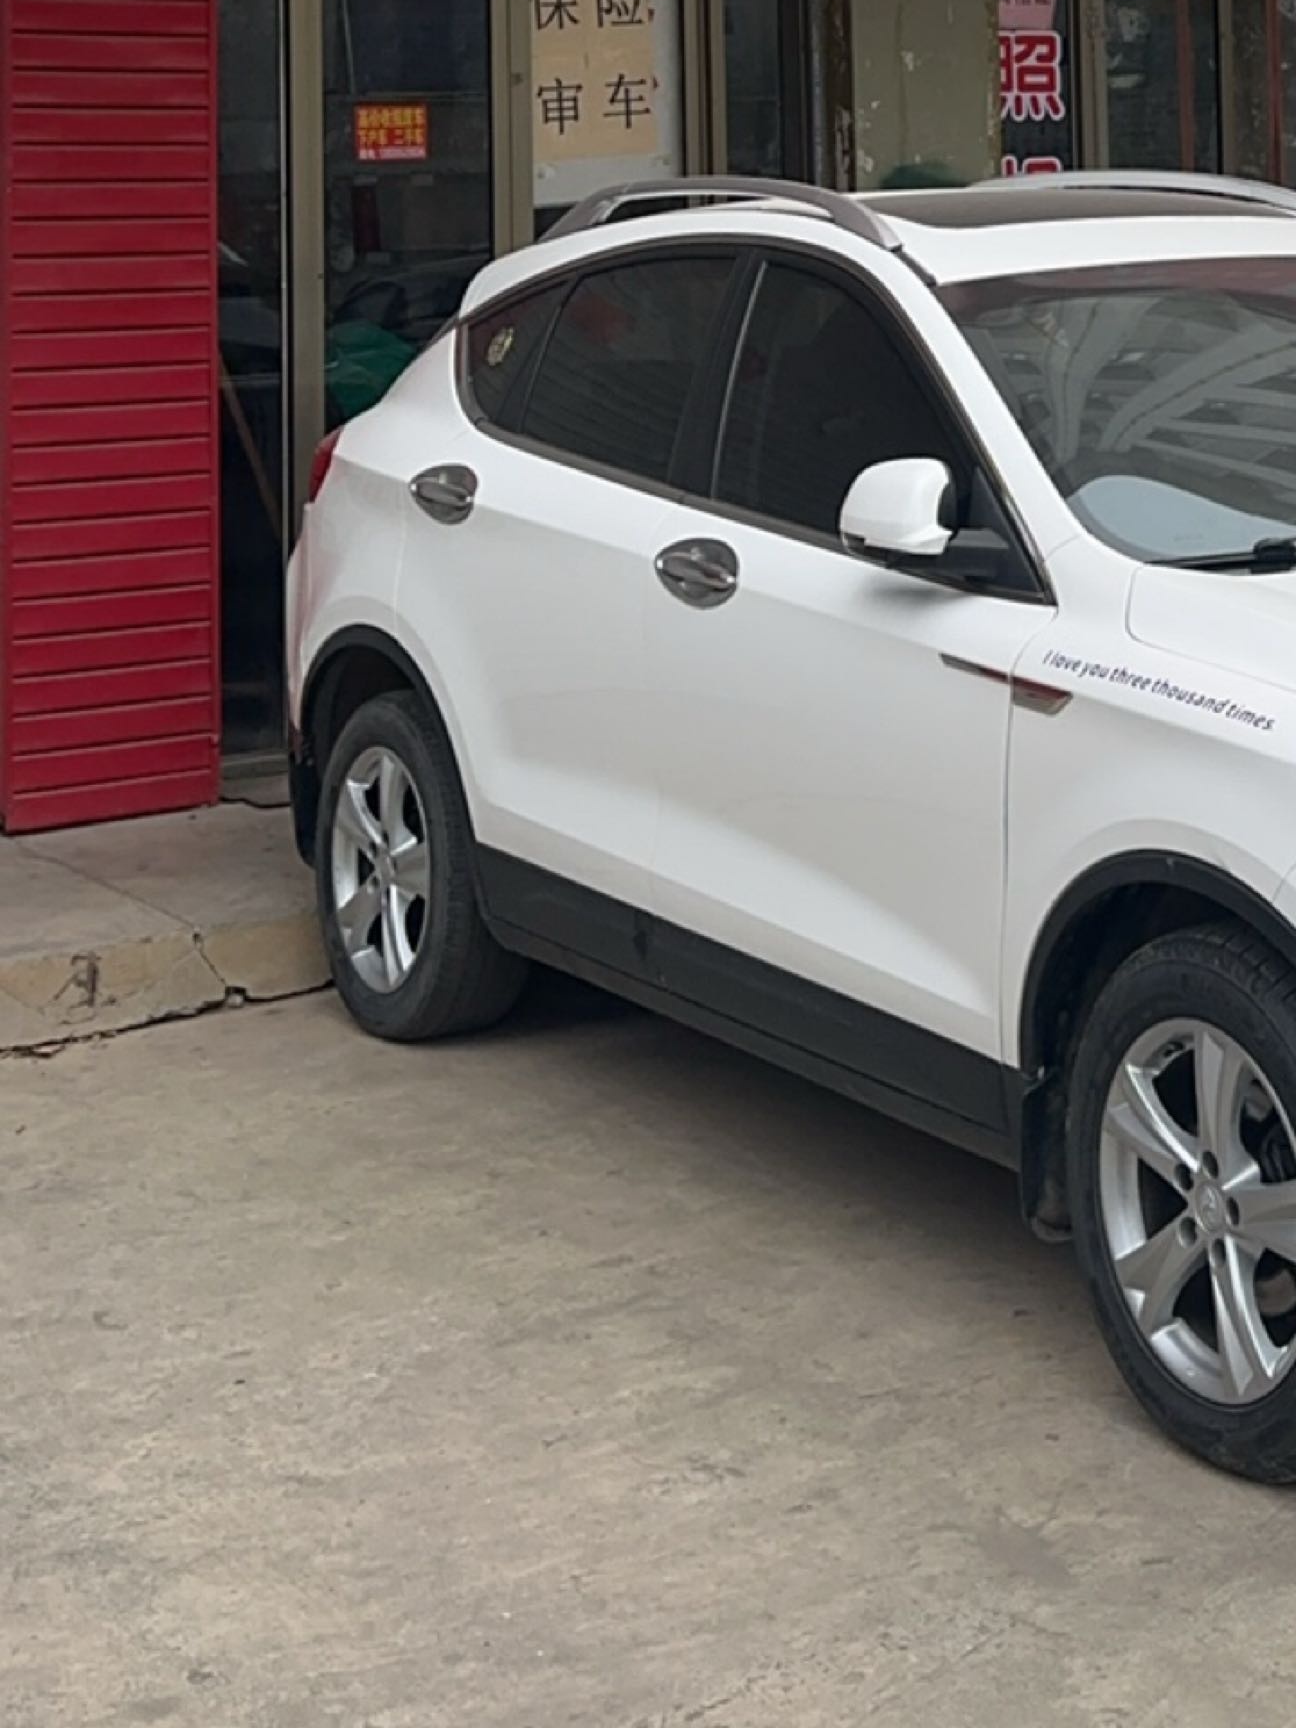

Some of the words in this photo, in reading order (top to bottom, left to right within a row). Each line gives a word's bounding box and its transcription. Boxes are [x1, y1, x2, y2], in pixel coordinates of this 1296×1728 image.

[536, 73, 652, 136] 审车
[1051, 651, 1082, 673] love
[1077, 661, 1110, 679] you
[1108, 666, 1152, 691] three
[1151, 677, 1230, 715] thousand
